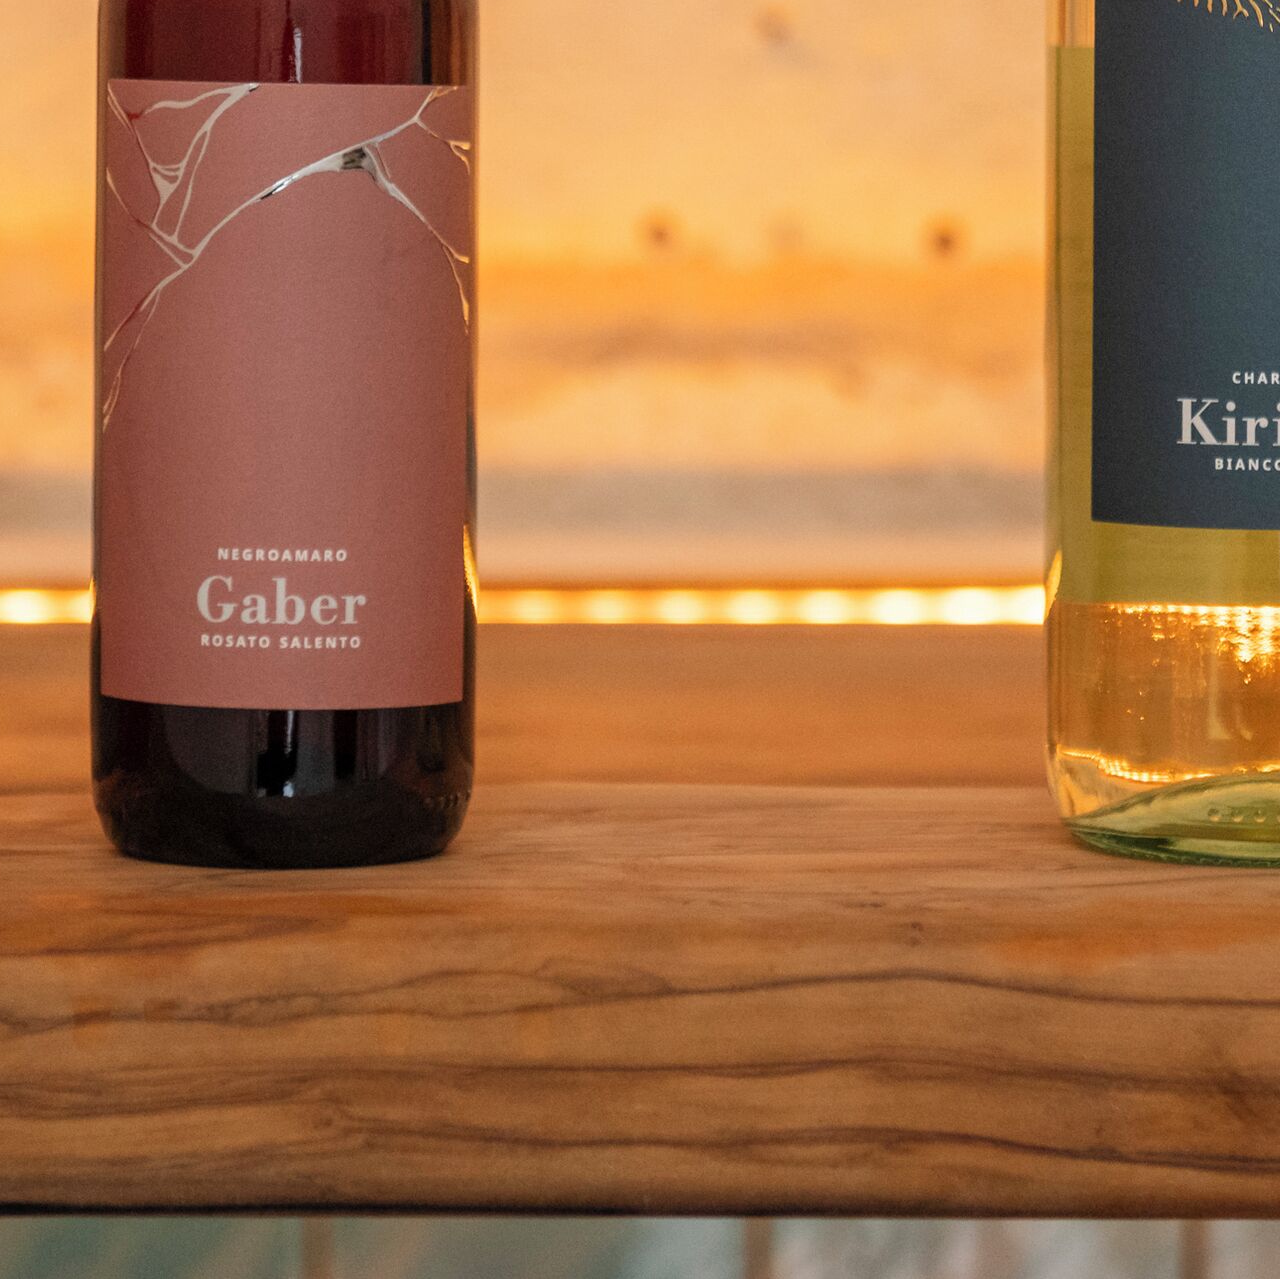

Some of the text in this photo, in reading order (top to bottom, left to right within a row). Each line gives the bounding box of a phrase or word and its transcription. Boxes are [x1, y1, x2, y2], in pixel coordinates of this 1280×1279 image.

[217, 548, 347, 561] NEGROAMARO
[196, 575, 367, 625] Gaber
[200, 634, 361, 649] ROSATO SALENTO
